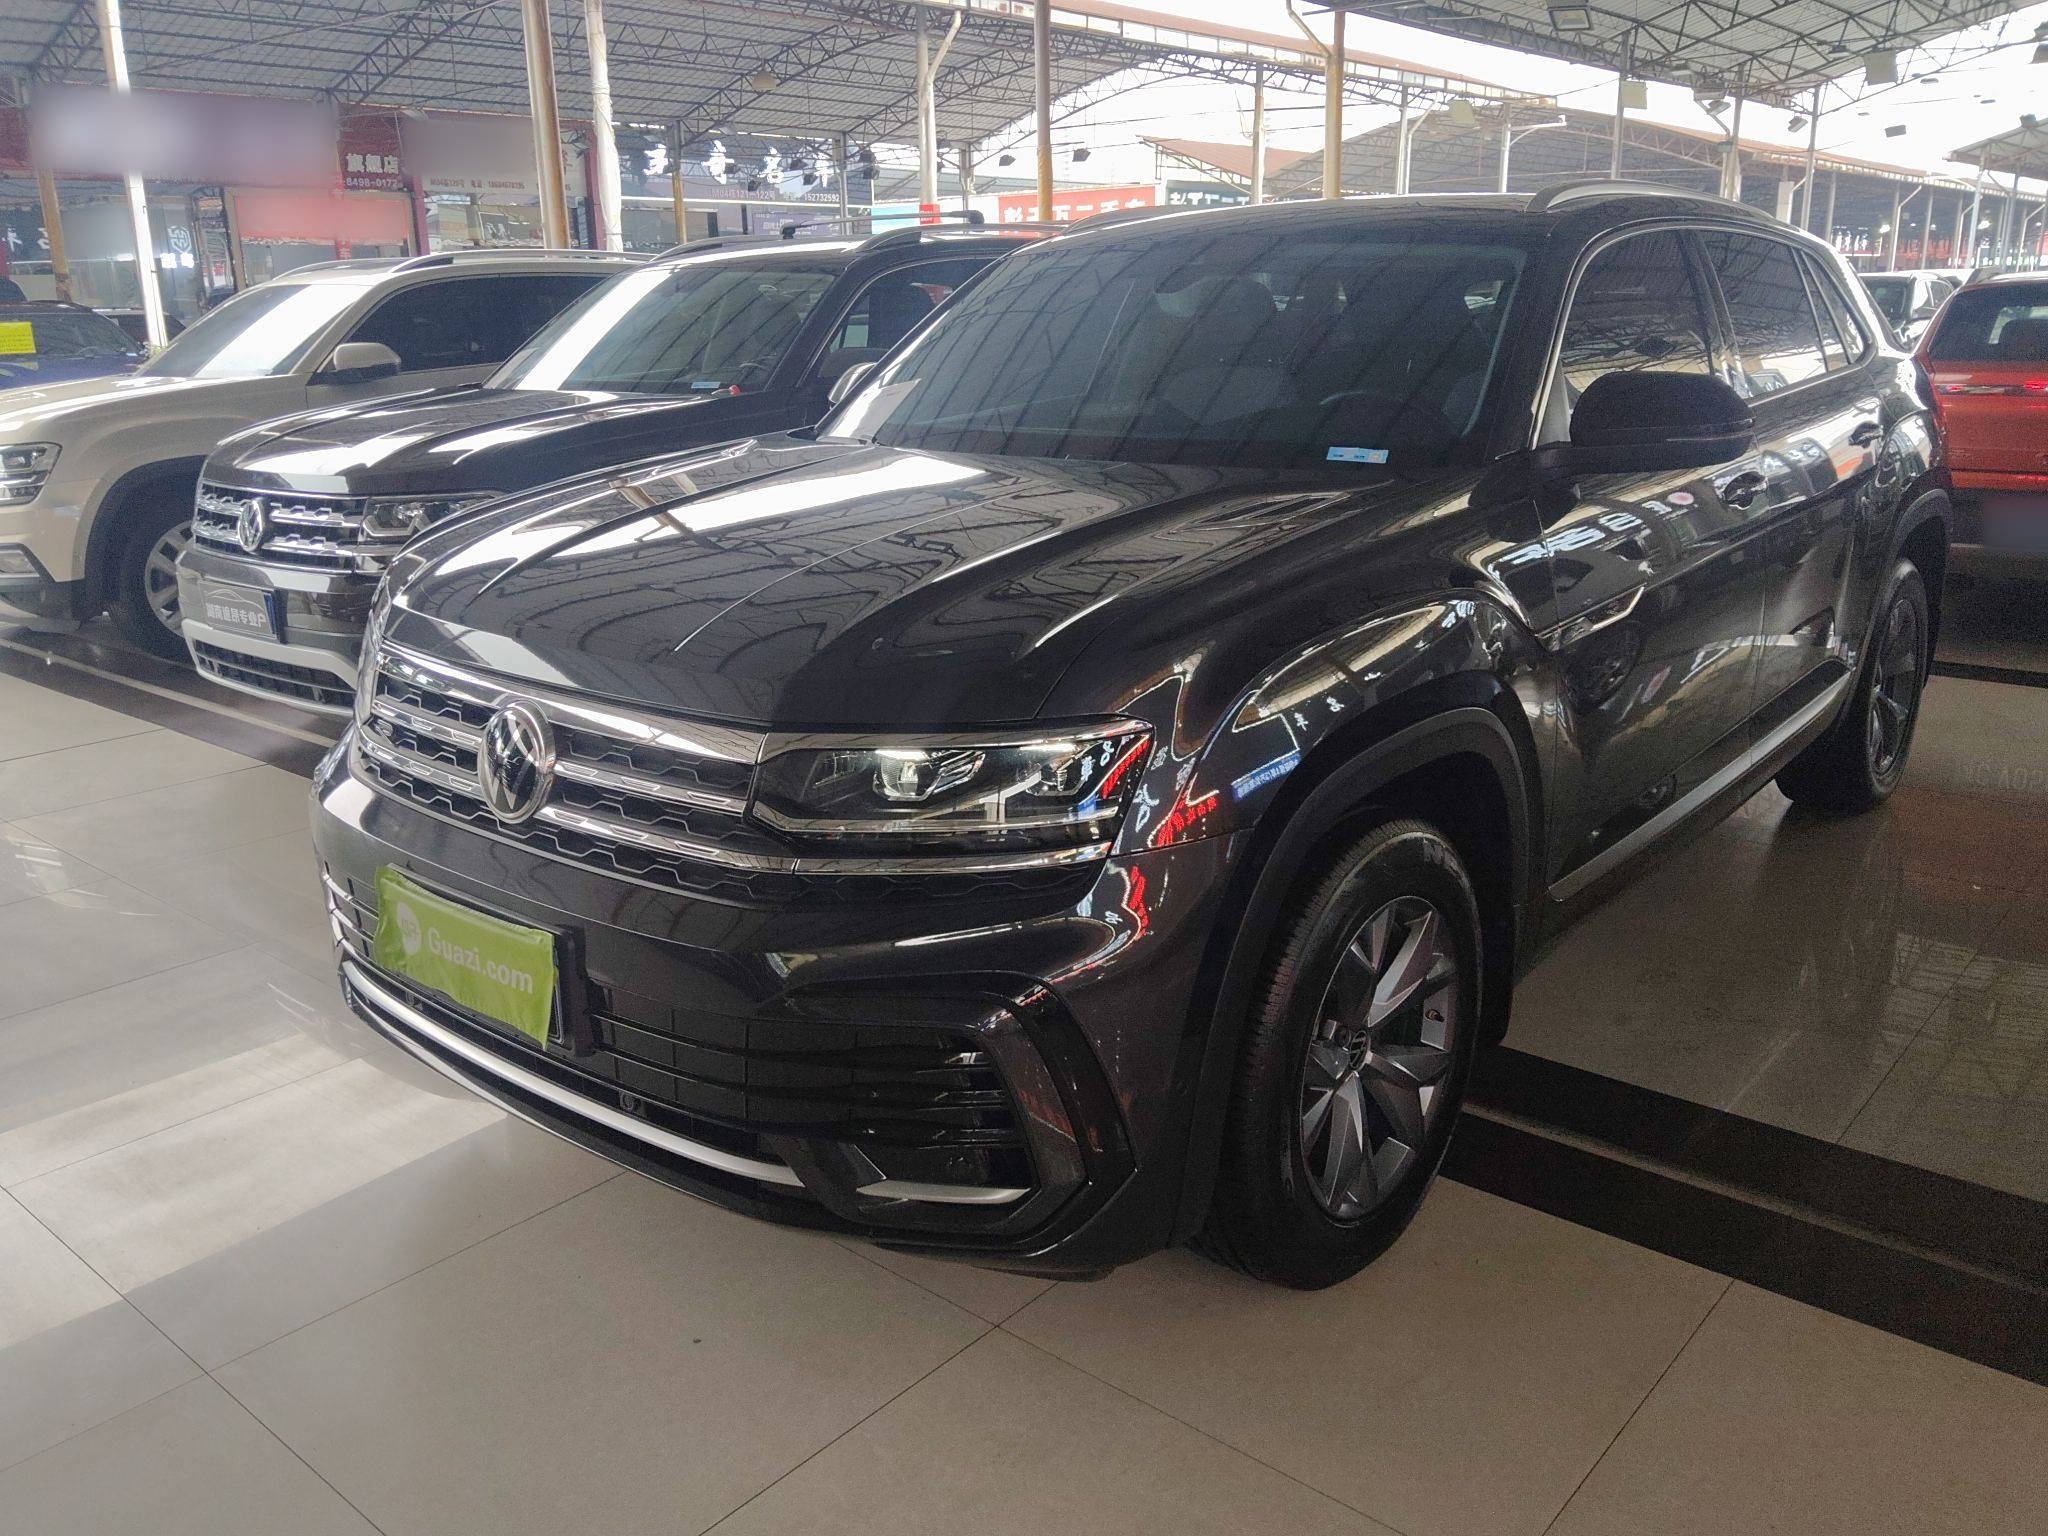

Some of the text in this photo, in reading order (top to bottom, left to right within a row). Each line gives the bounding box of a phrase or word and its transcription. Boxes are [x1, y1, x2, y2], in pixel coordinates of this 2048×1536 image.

[345, 153, 399, 174] 旗舰店
[428, 926, 534, 995] Guazi.com
